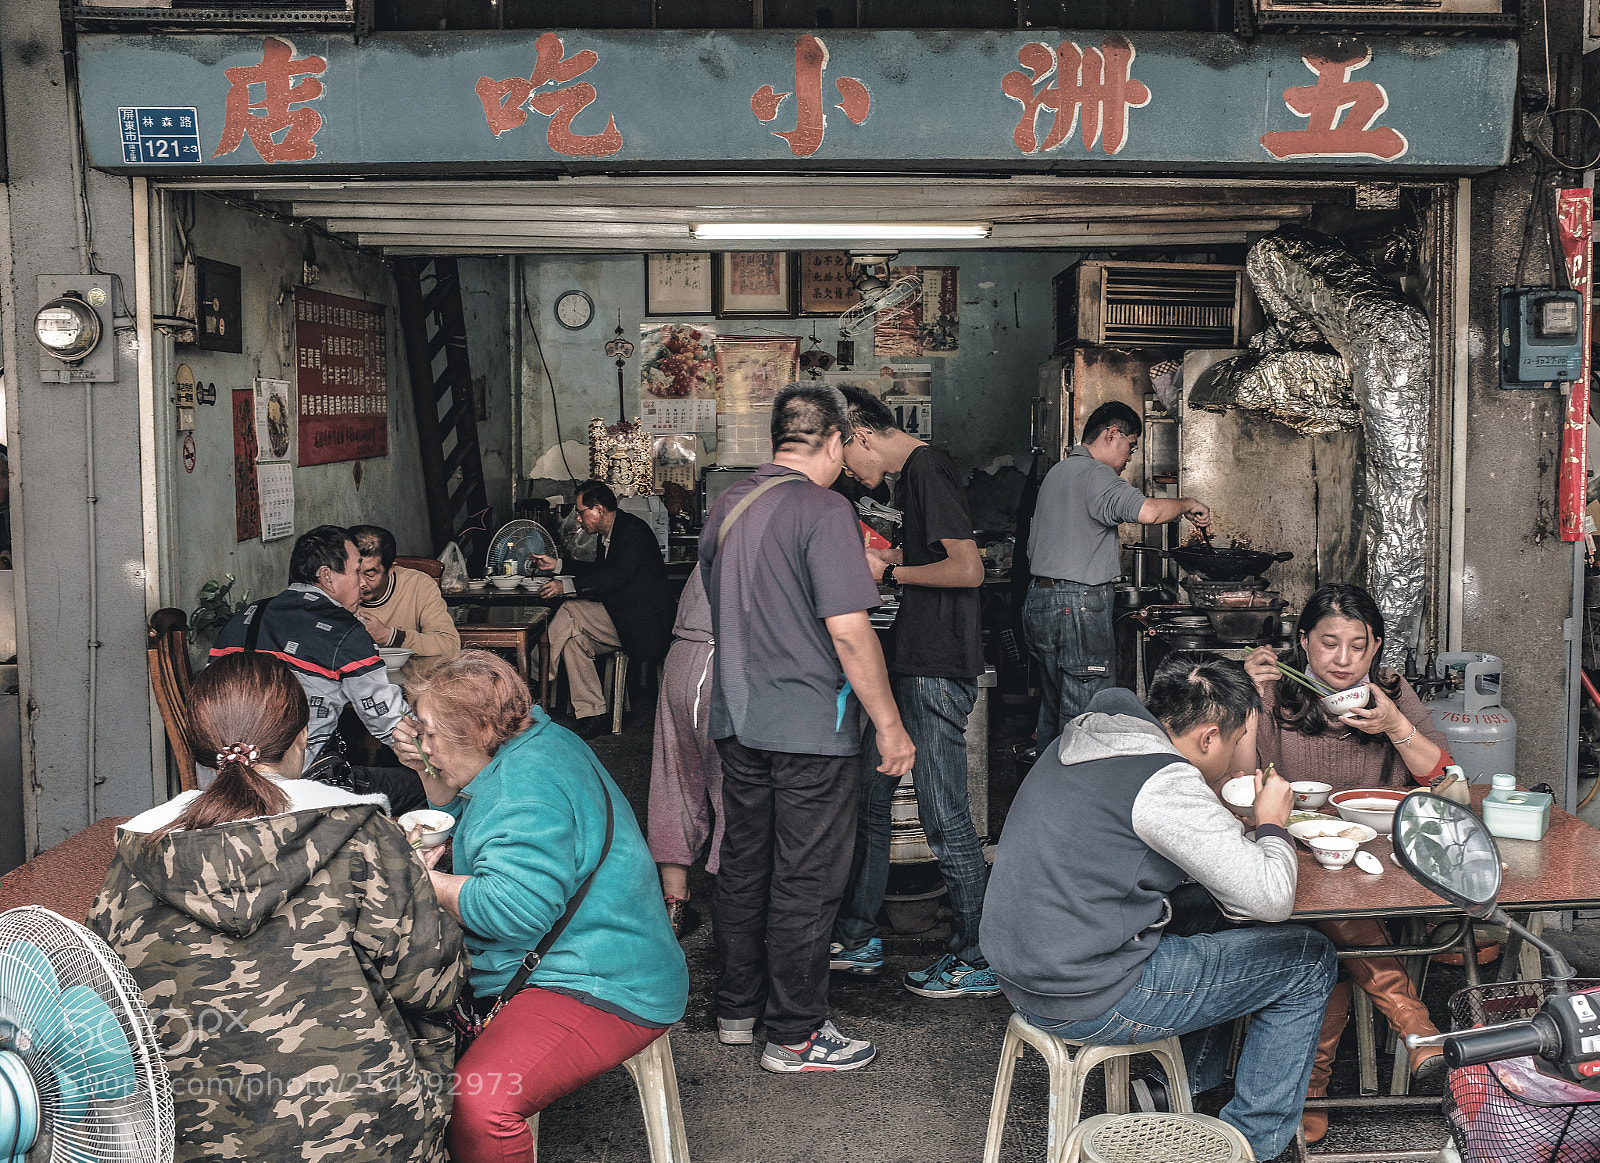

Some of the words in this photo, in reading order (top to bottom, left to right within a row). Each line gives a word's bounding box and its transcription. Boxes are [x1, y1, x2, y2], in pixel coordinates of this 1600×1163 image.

[123, 109, 137, 141] 屏東市
[142, 116, 192, 128] 林森路
[145, 139, 180, 158] 121
[894, 405, 920, 434] 14
[1441, 711, 1508, 724] 7661893
